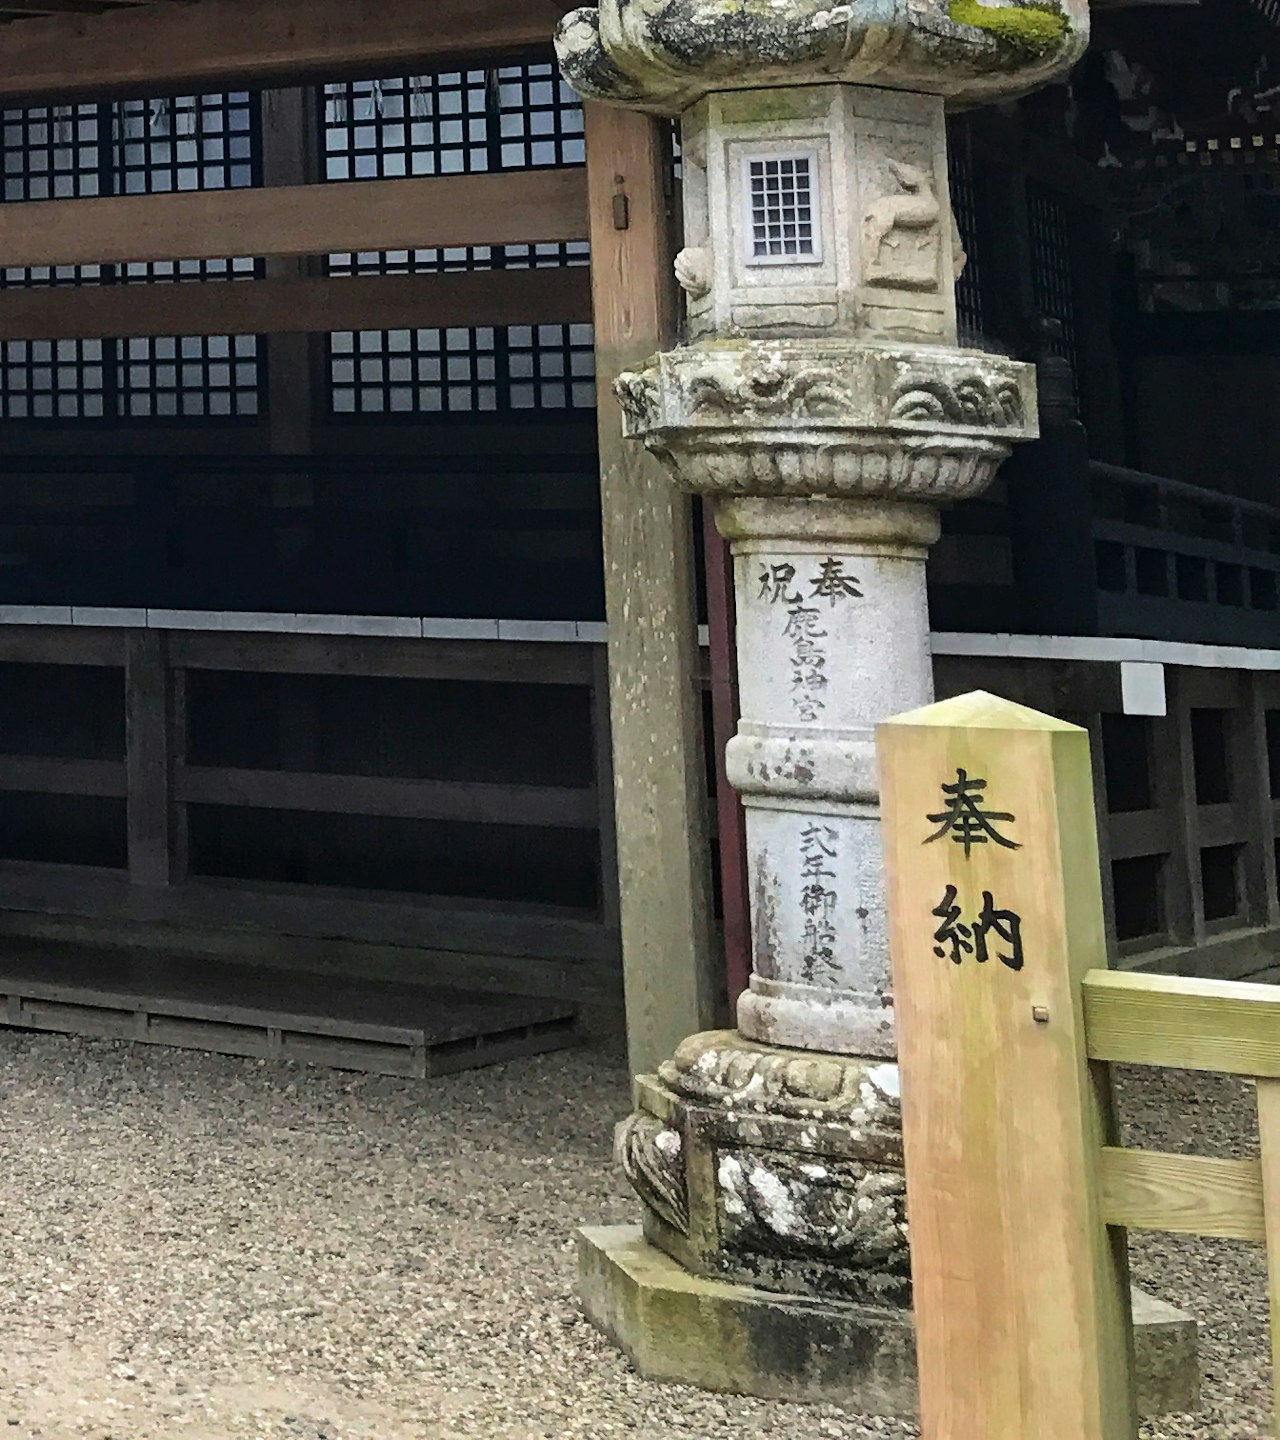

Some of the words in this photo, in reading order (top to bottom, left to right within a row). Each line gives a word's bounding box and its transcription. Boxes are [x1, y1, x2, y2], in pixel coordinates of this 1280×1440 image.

[782, 606, 828, 722] 鹿島神宮
[922, 768, 1024, 971] 奉納
